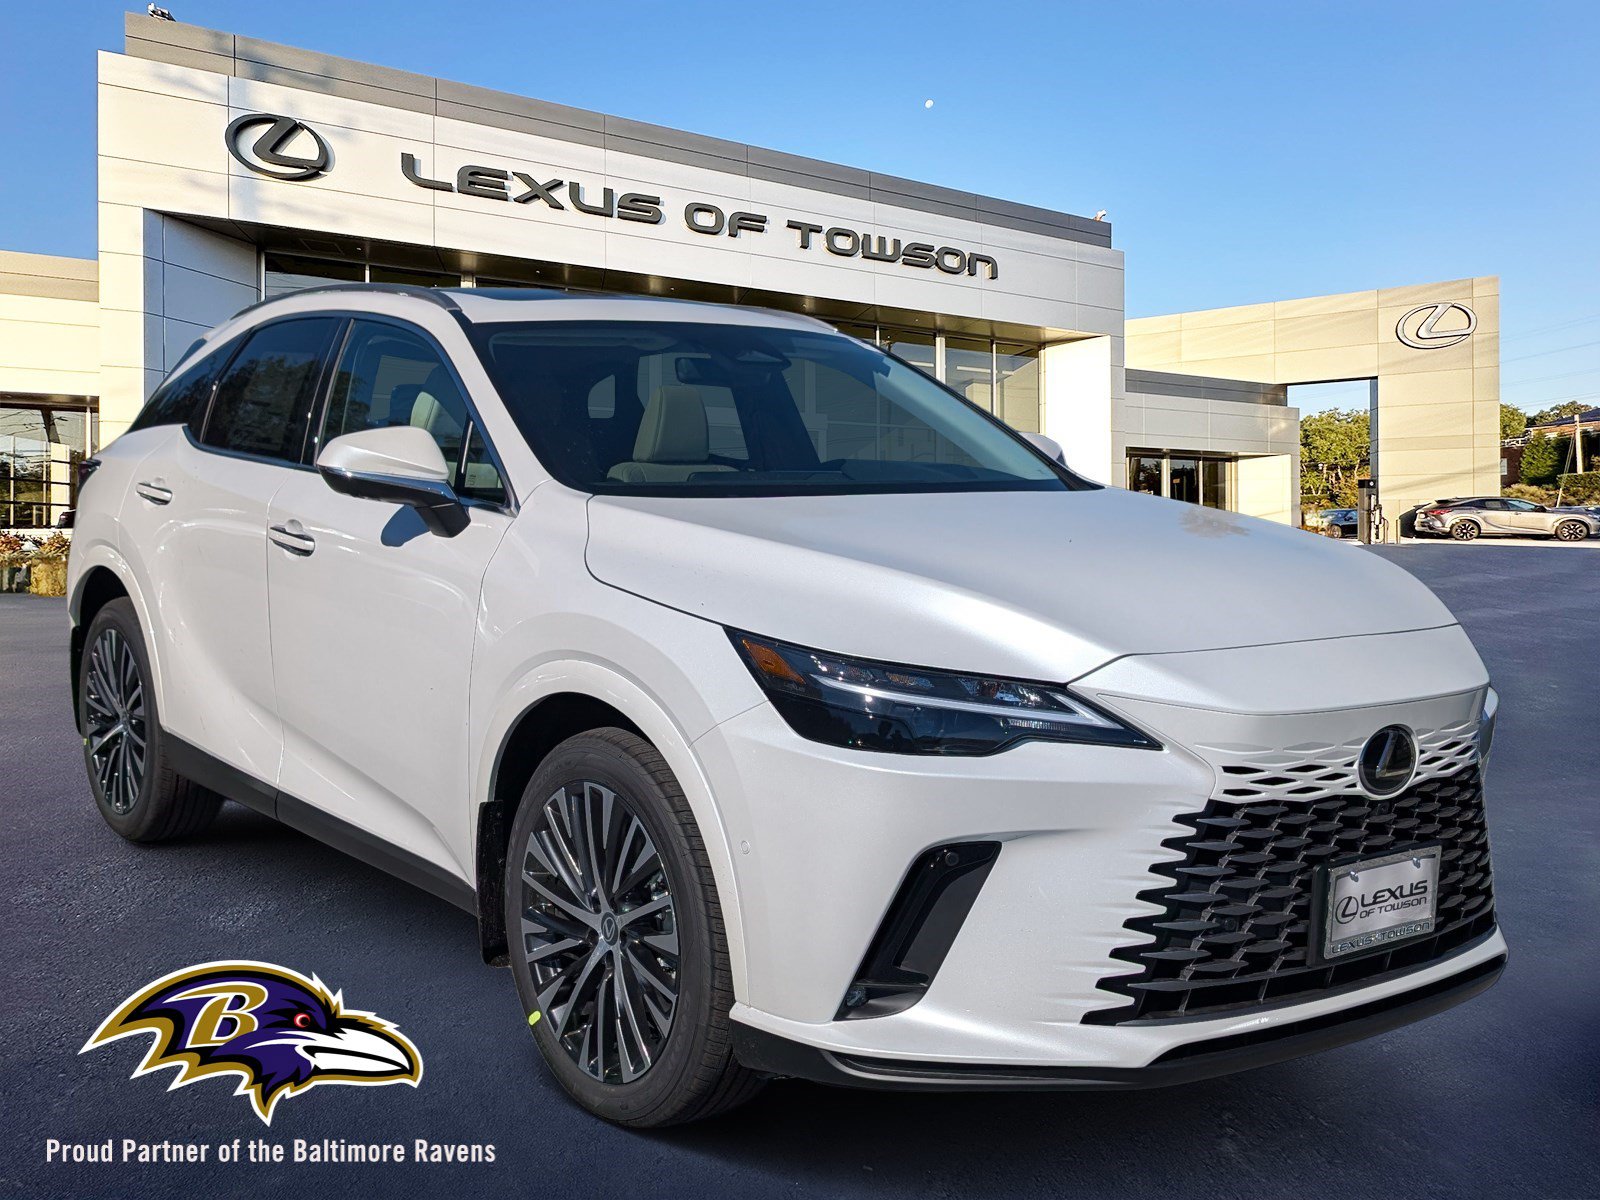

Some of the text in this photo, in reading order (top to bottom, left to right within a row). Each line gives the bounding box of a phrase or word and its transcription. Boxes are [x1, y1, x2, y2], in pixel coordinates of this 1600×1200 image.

[401, 152, 998, 280] LEXUS OF TOWSON
[1359, 896, 1428, 919] OF TOWSON
[1361, 880, 1428, 908] LEXUS
[1331, 922, 1430, 954] LEXUS TOWSON
